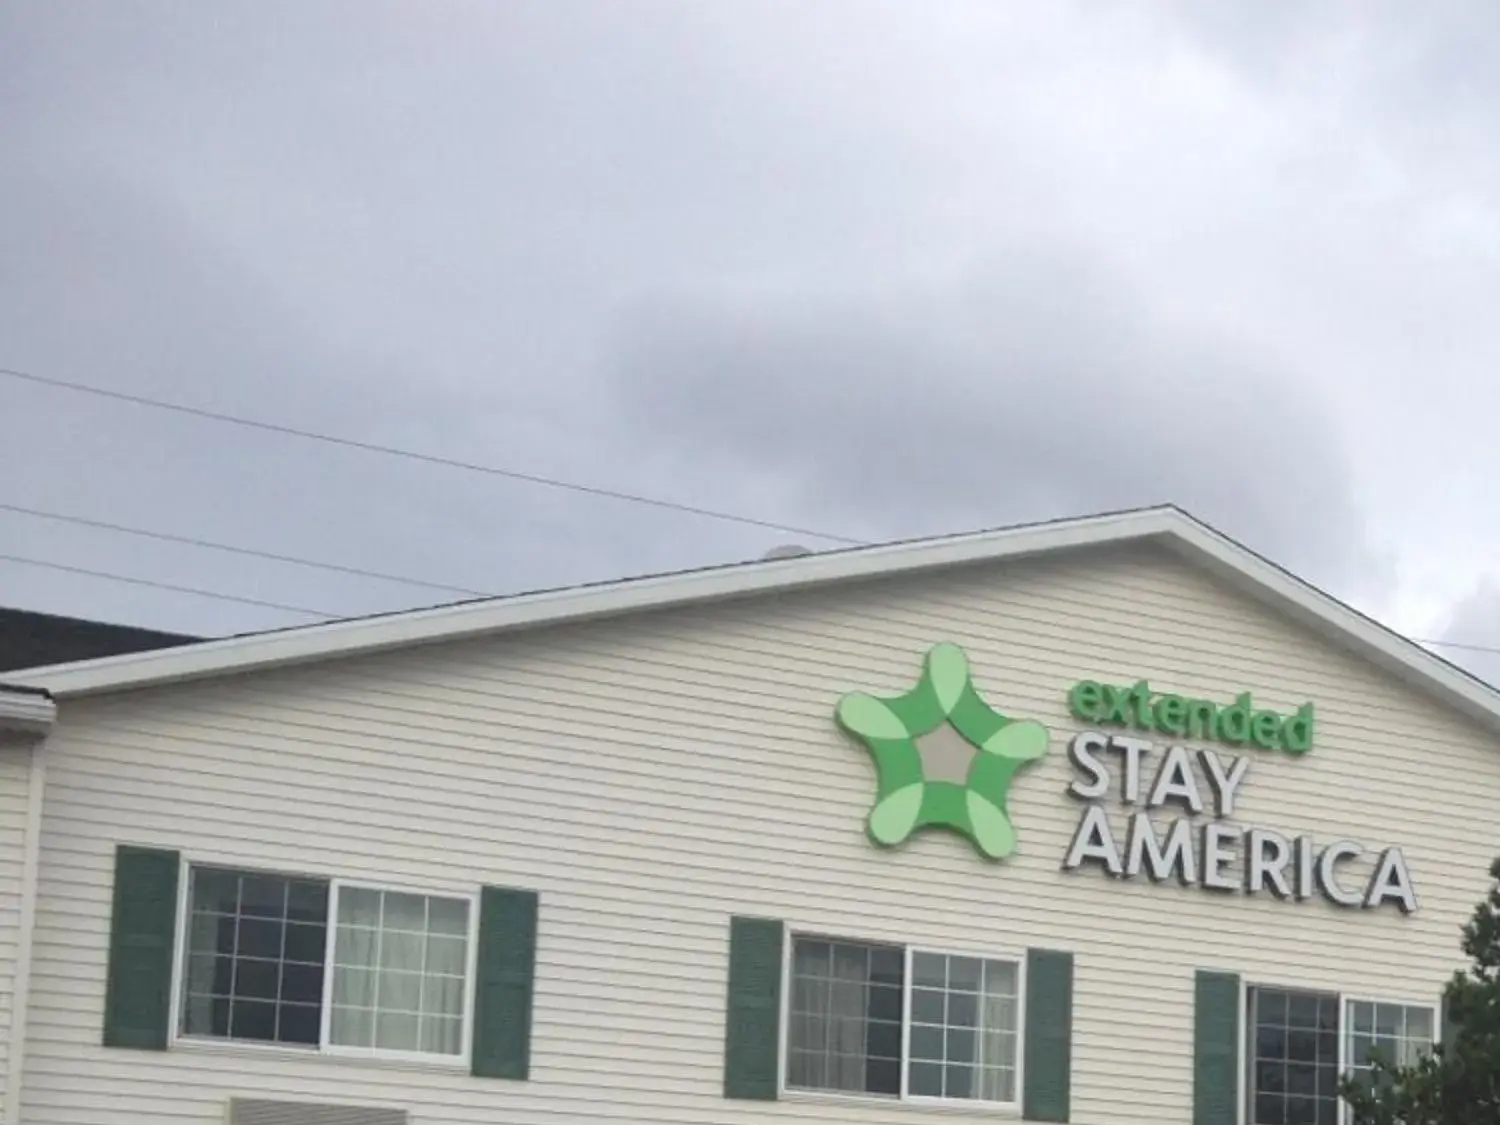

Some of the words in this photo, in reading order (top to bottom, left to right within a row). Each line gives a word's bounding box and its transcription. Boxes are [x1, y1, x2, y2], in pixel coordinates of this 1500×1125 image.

[1068, 679, 1315, 753] extended
[1068, 732, 1249, 818] STAY
[1063, 806, 1417, 912] AMERICA
